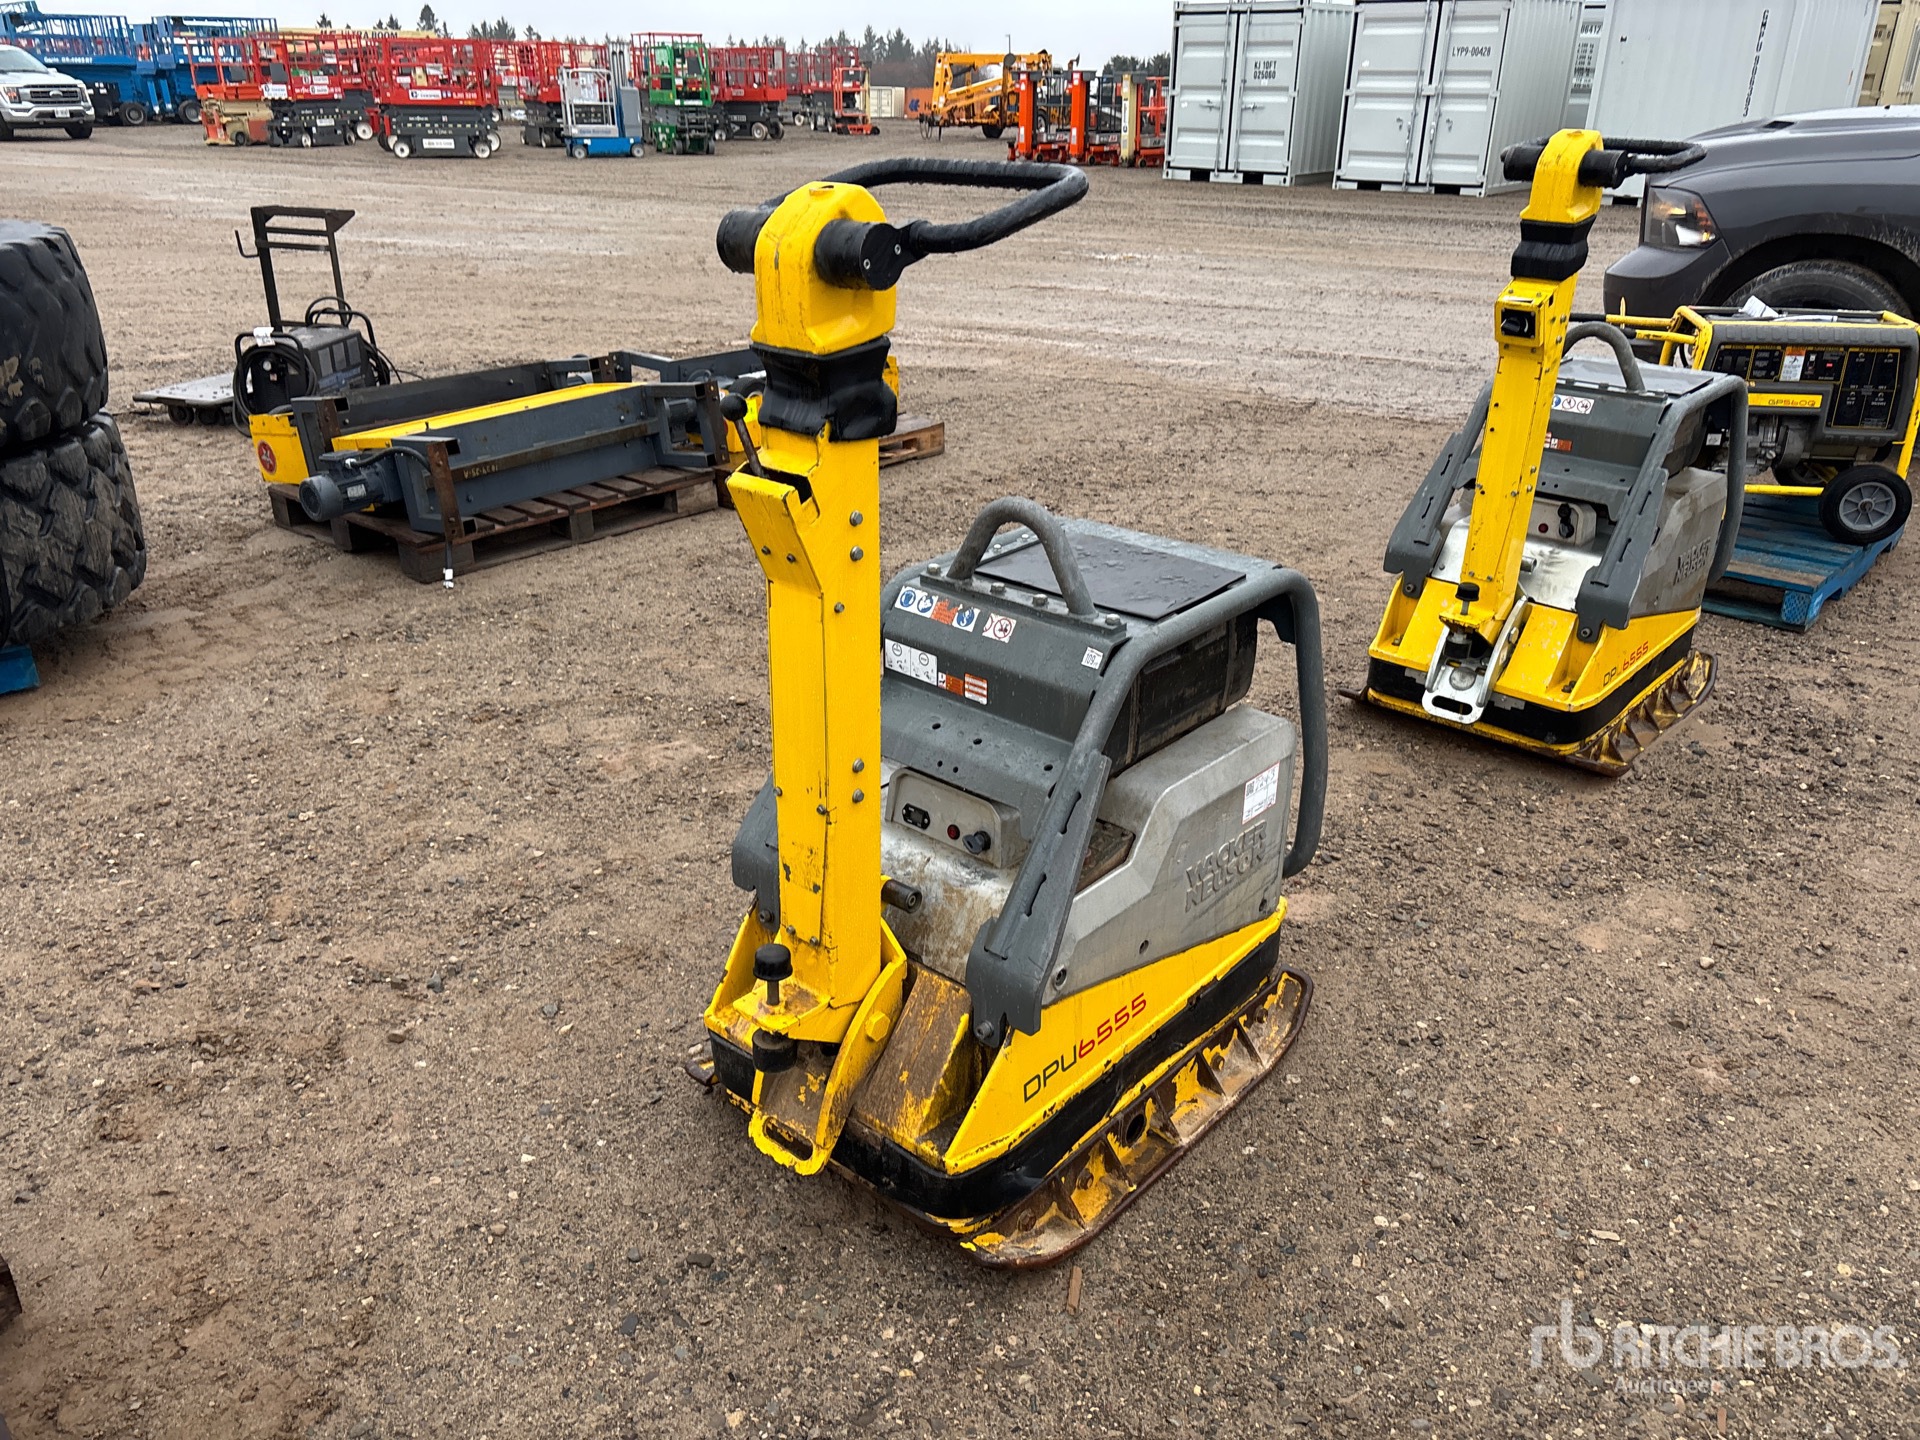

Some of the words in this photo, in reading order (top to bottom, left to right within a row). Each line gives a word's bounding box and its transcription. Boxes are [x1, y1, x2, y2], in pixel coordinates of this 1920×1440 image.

[1185, 844, 1267, 913] NEUSON
[1186, 819, 1268, 888] WACKER
[1023, 992, 1147, 1103] DPU6555
